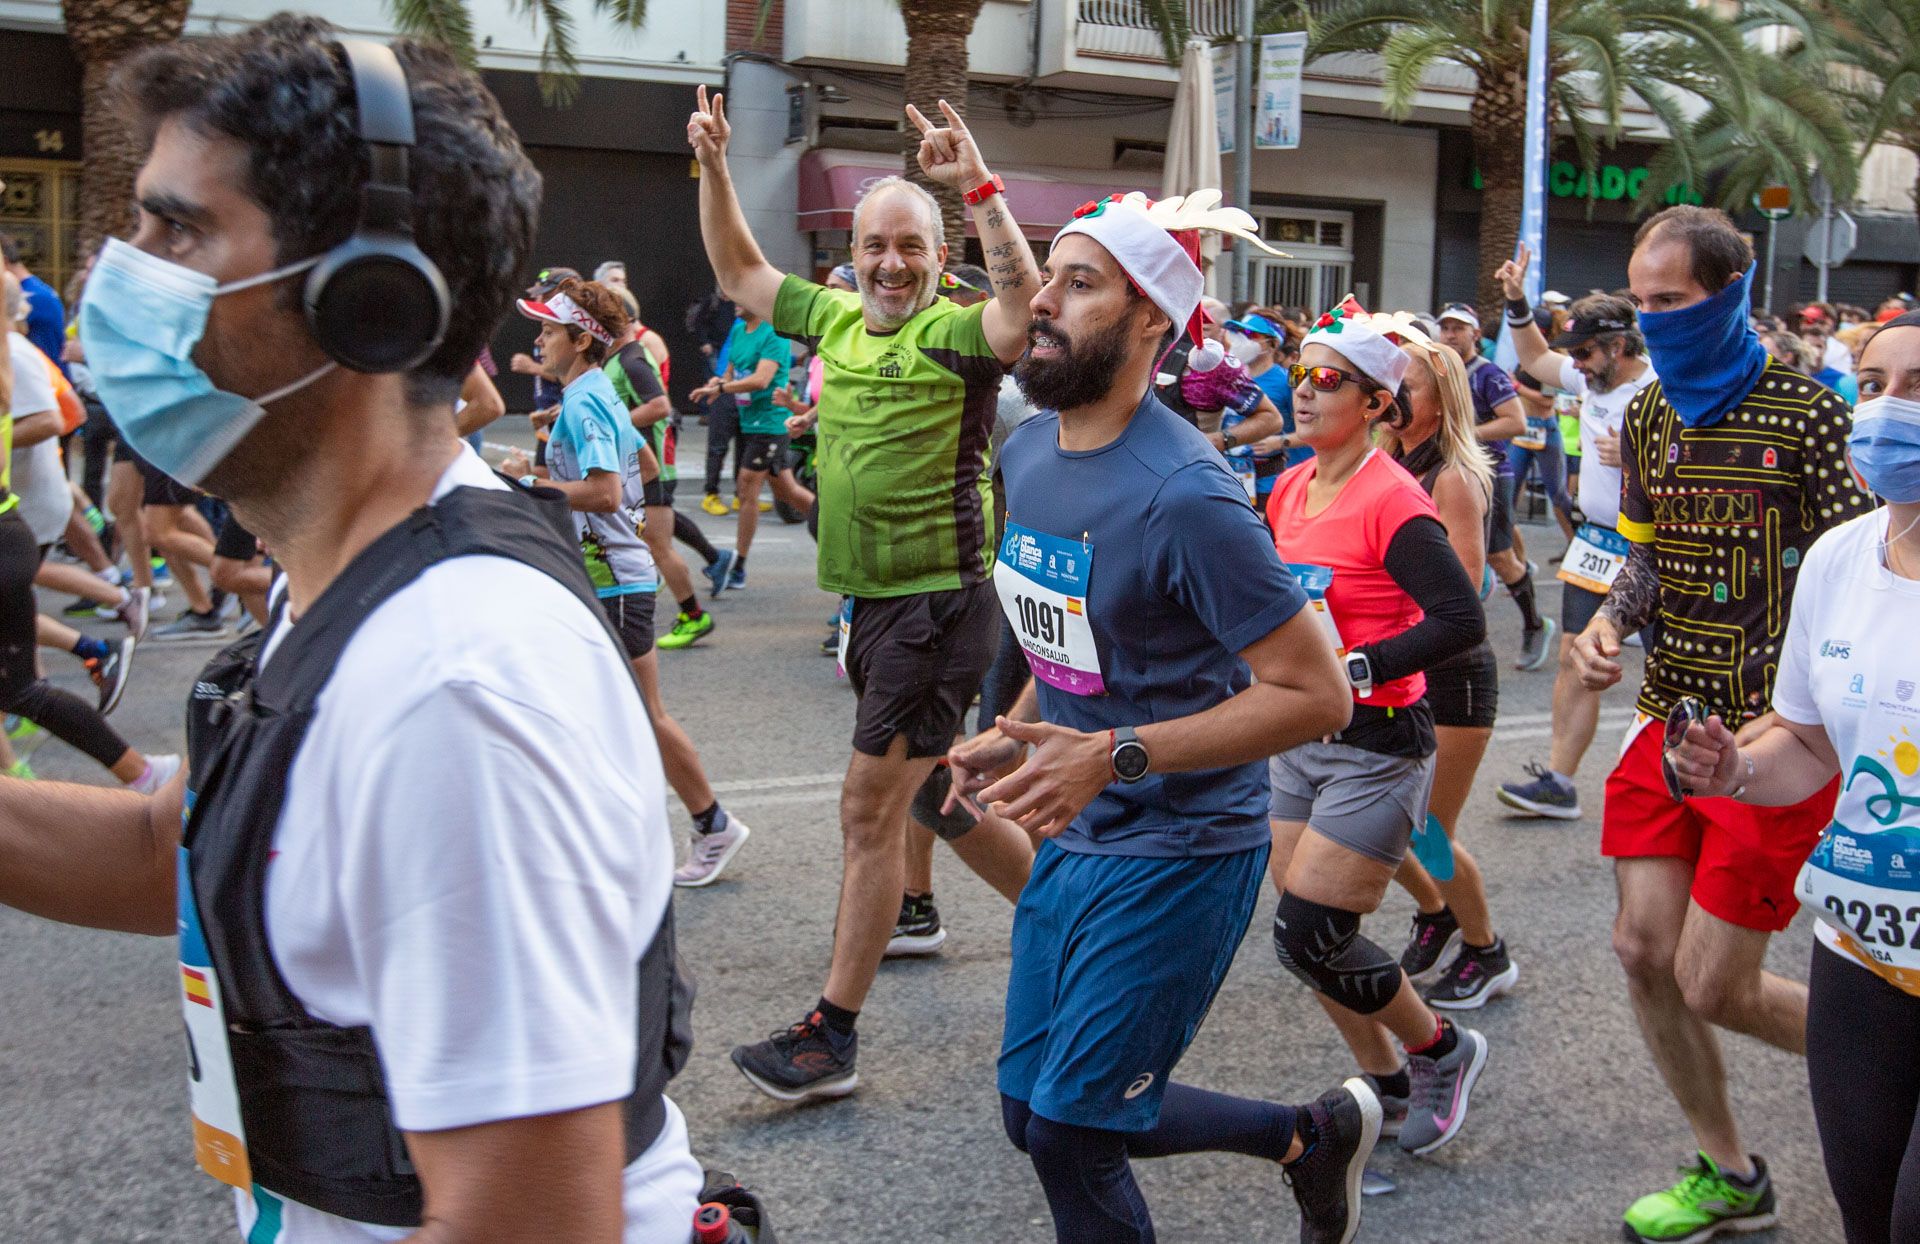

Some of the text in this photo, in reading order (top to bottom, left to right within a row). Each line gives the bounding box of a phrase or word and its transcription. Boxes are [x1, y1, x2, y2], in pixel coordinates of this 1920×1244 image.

[33, 130, 64, 152] 14
[1695, 493, 1756, 523] RUN
[1020, 541, 1043, 558] blanca
[1579, 552, 1611, 575] 2317
[1015, 594, 1065, 648] 1097
